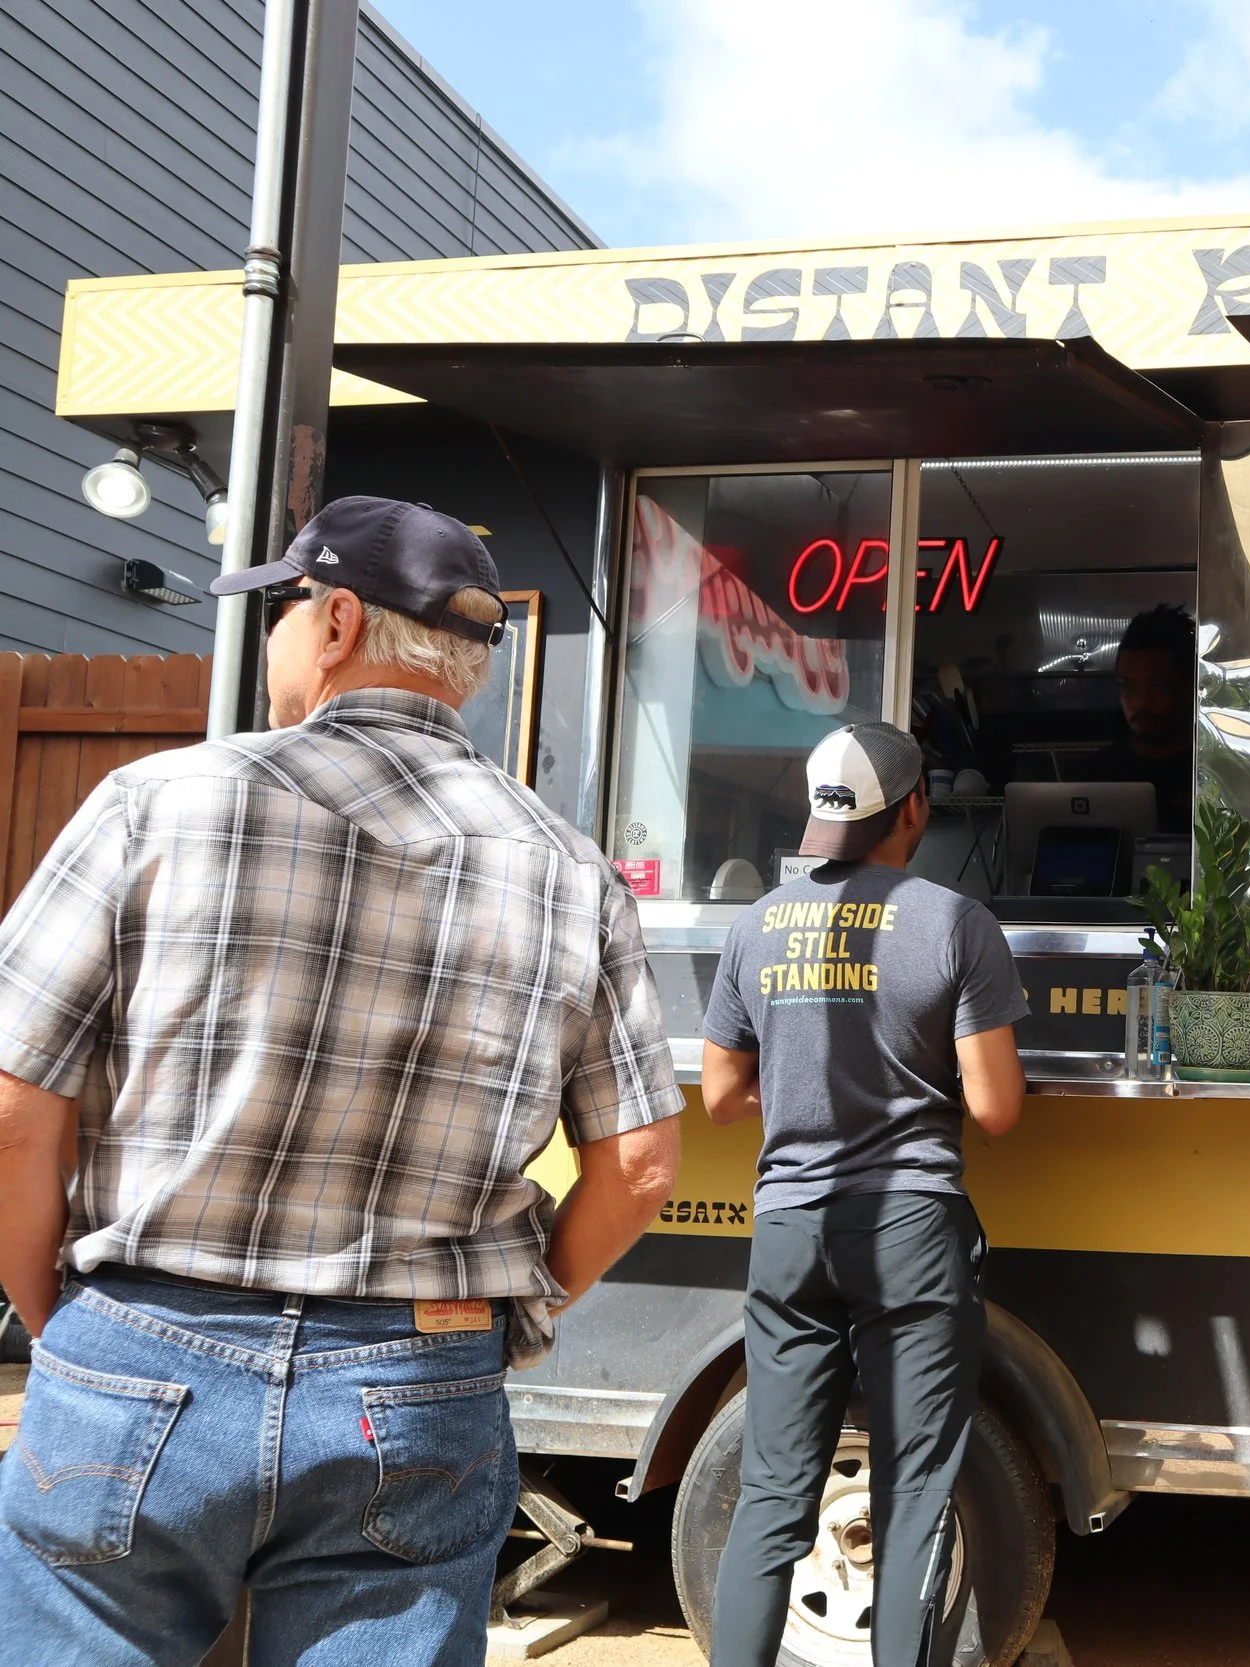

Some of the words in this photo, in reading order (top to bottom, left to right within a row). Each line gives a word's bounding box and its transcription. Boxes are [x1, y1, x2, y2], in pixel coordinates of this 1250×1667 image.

[624, 255, 1107, 343] DISTANT
[785, 865, 799, 874] No
[762, 903, 898, 933] SUNNYSIDE
[786, 932, 850, 959] STILL
[760, 963, 878, 995] STANDING
[1050, 988, 1128, 1015] HER
